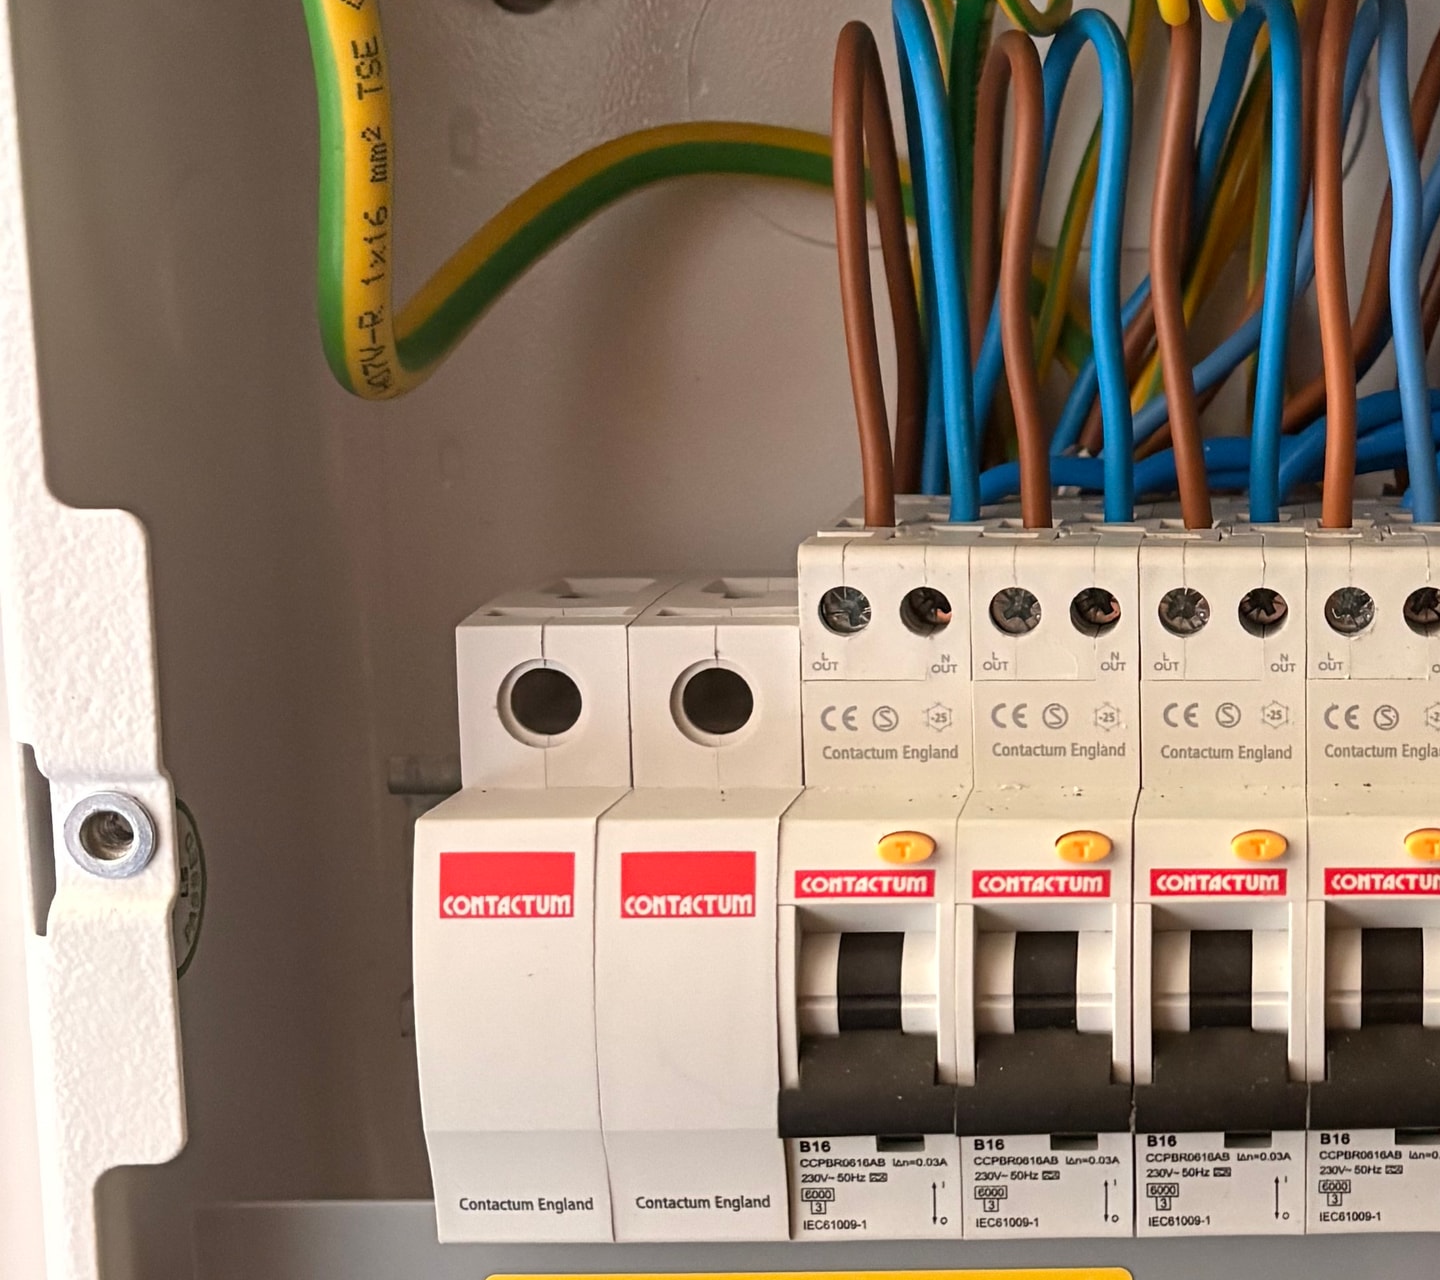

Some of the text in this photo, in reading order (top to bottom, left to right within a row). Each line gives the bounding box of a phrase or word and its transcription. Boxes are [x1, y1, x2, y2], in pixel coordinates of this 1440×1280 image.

[350, 34, 385, 102] TSE
[800, 876, 929, 895] CONTACTUM
[442, 894, 572, 917] CONTACTUM
[623, 894, 754, 917] CONTACTUM
[800, 1141, 832, 1153] B16
[836, 1172, 867, 1183] 50Hz
[458, 1194, 594, 1215] Contactum England
[803, 1220, 868, 1231] IEC61009-1
